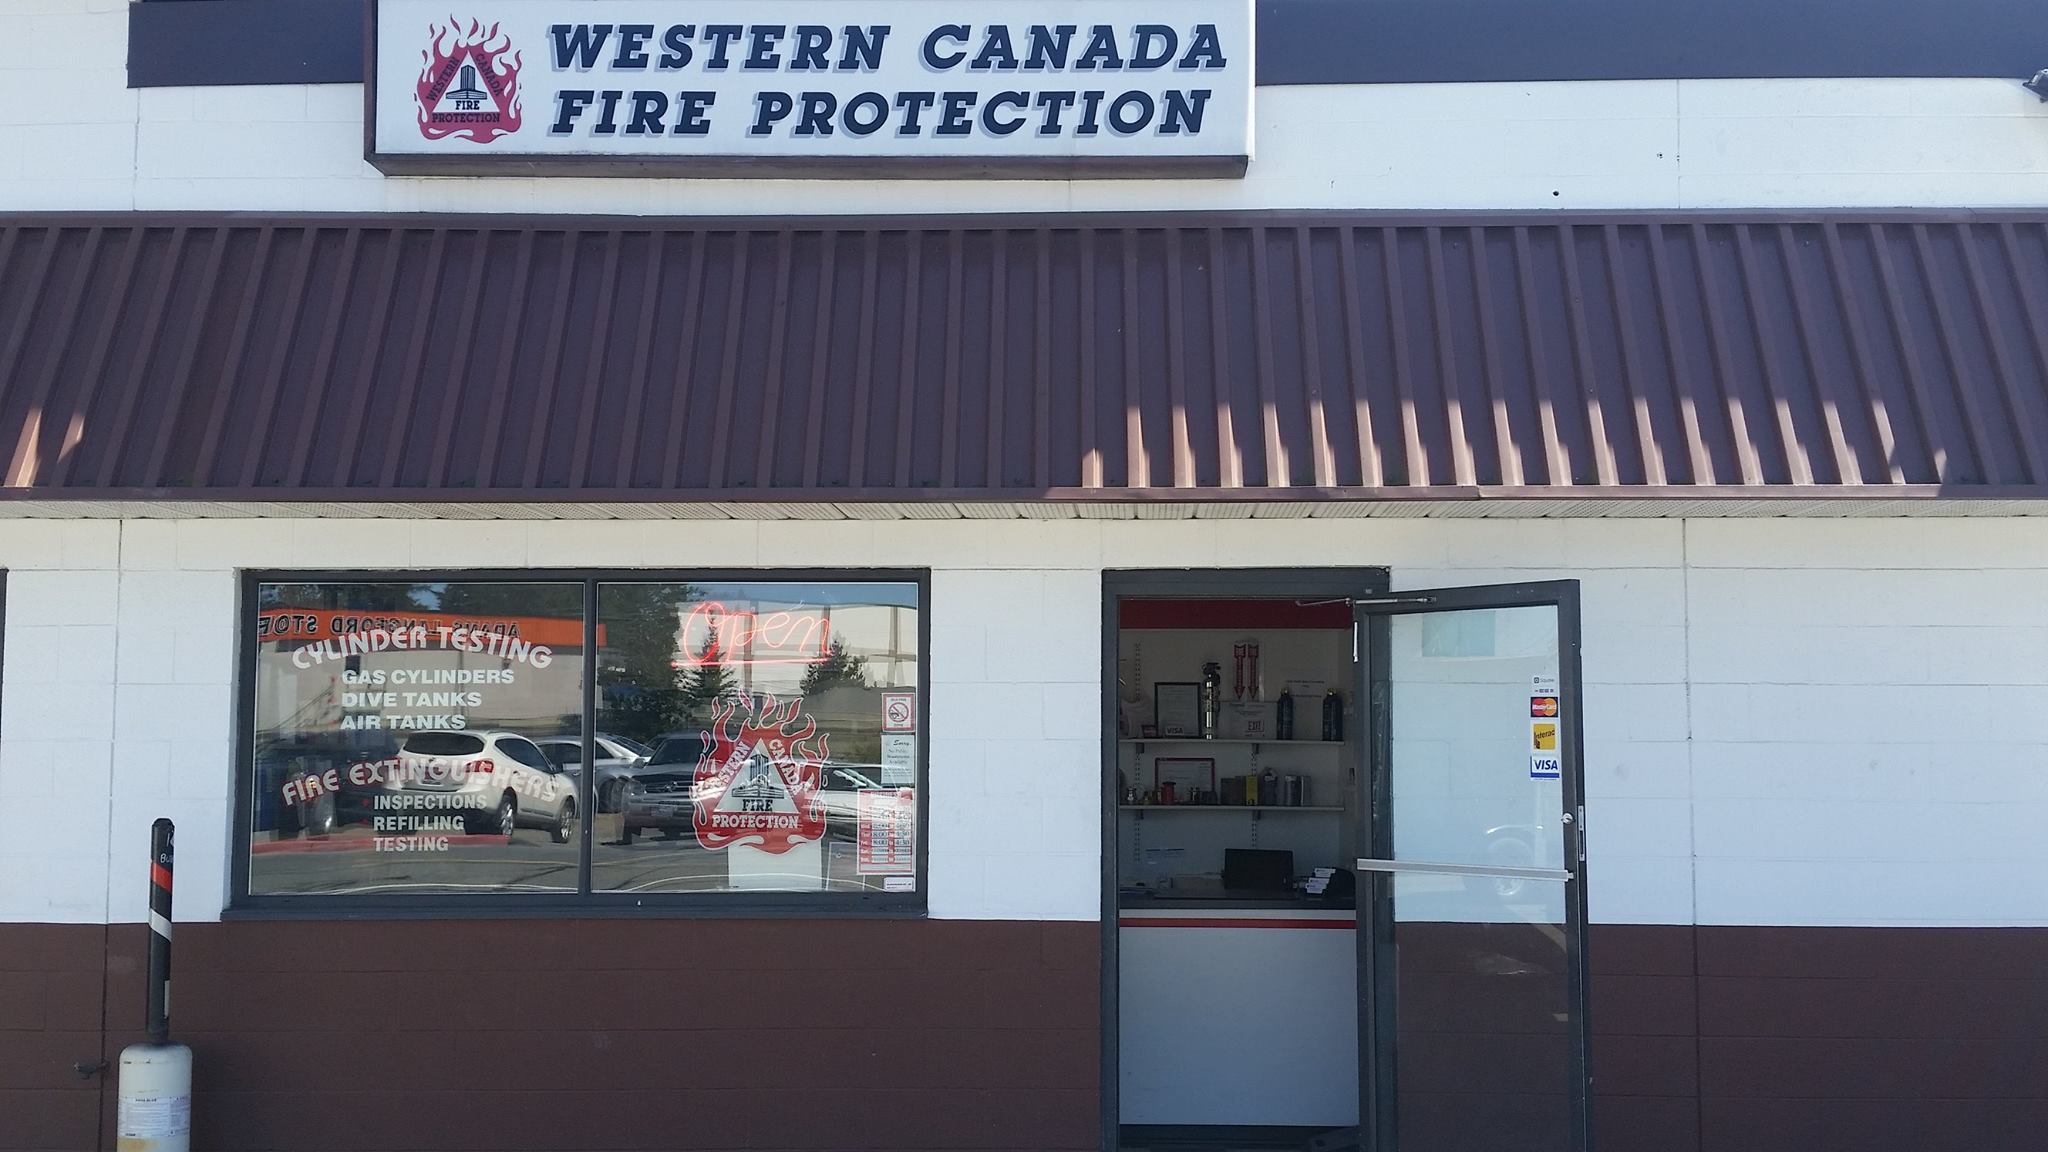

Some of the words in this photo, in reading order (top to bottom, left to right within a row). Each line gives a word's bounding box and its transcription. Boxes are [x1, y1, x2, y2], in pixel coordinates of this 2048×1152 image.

[546, 24, 891, 73] WESTERN
[918, 24, 1228, 73] CANADA
[426, 56, 460, 101] WESTERN
[475, 53, 504, 97] CANADA
[455, 100, 480, 110] FIRE
[432, 112, 500, 123] PROTECTION
[547, 90, 716, 138] FIRE
[745, 89, 1212, 139] PROTECTION
[683, 601, 833, 663] Open
[292, 626, 426, 670] CYLINDER
[437, 626, 553, 669] TESTING
[341, 669, 386, 685] GAS
[391, 669, 515, 685] CYLINDERS
[341, 692, 397, 707] DIVE
[403, 692, 482, 707] TANKS
[340, 714, 382, 730] AIR
[387, 714, 466, 730] TANKS
[1534, 759, 1558, 770] VISA
[281, 768, 340, 807] FIRE
[349, 757, 561, 803] EXTINGUISHERS
[373, 795, 488, 810] INSPECTIONS
[742, 799, 773, 812] FIRE
[373, 816, 465, 831] REFILLING
[712, 814, 800, 829] PROTECTION
[373, 837, 449, 852] TESTING
